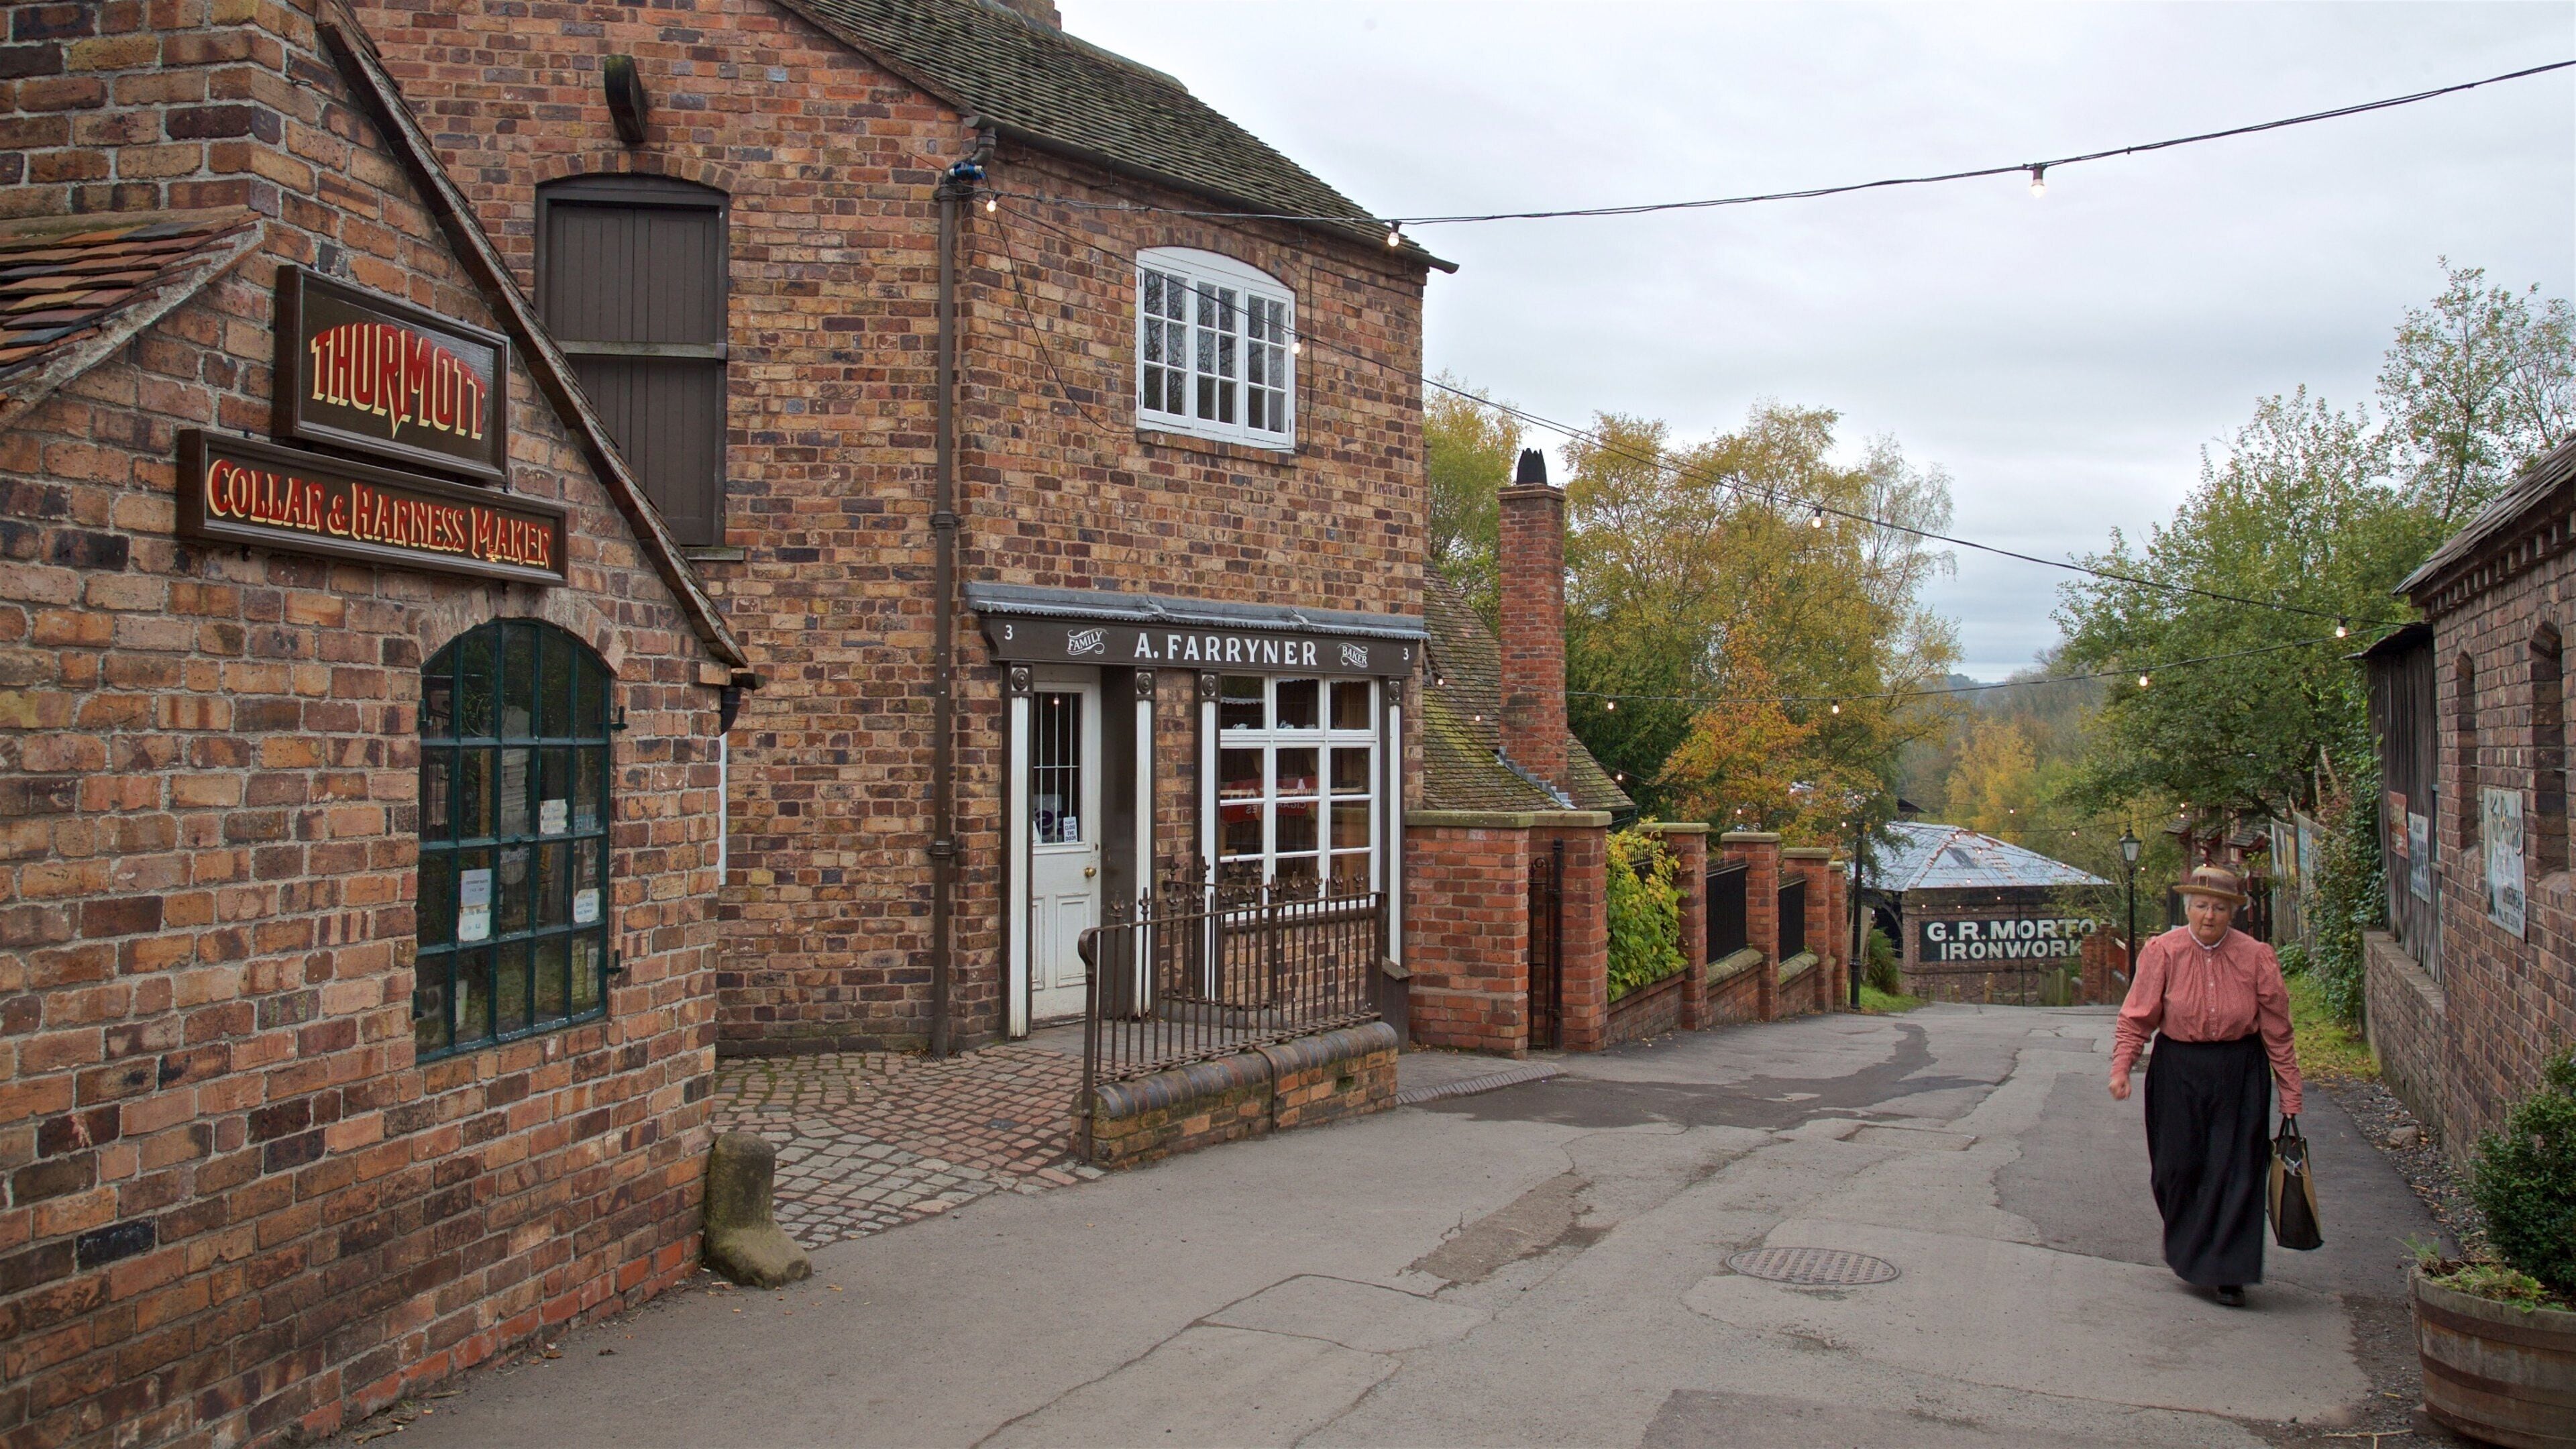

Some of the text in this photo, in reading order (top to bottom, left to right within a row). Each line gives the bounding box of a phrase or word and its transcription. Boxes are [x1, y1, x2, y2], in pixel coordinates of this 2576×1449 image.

[311, 323, 486, 440] THURMOTT
[207, 459, 551, 569] COLLAR & HARNESS MAKER
[1005, 625, 1013, 640] 3
[1067, 631, 1103, 651] FAMILY
[1134, 633, 1318, 666] A. FARRYNER
[1342, 645, 1368, 665] BAKER
[1403, 647, 1409, 661] 3
